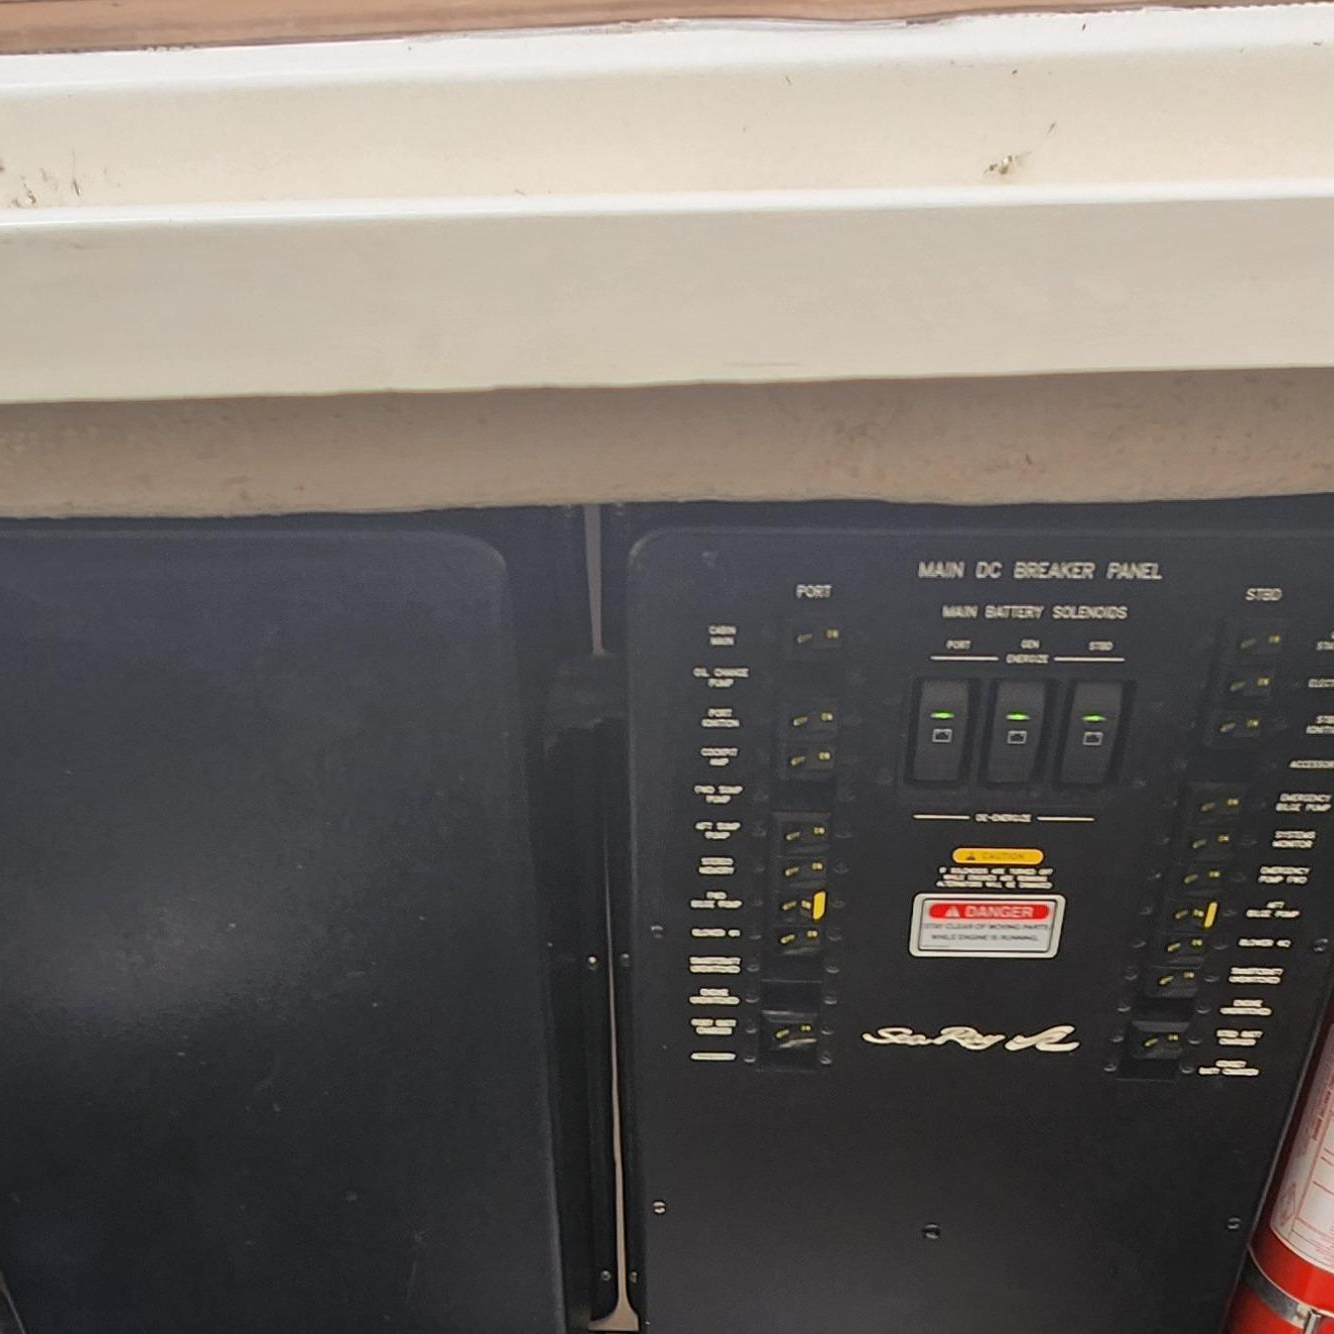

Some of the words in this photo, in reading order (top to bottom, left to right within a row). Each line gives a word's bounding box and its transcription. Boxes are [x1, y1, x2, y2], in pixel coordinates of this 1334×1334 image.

[918, 561, 965, 579] MAIN
[975, 561, 1003, 579] DC
[1013, 561, 1096, 580] BREAKER
[1106, 561, 1163, 580] PANEL
[796, 584, 832, 598] PORT
[1245, 587, 1283, 601] STBD
[942, 605, 978, 619] MAIN
[984, 605, 1045, 619] BATTERY
[1052, 605, 1129, 620] SOLENOIDS
[964, 905, 1034, 919] DANGER
